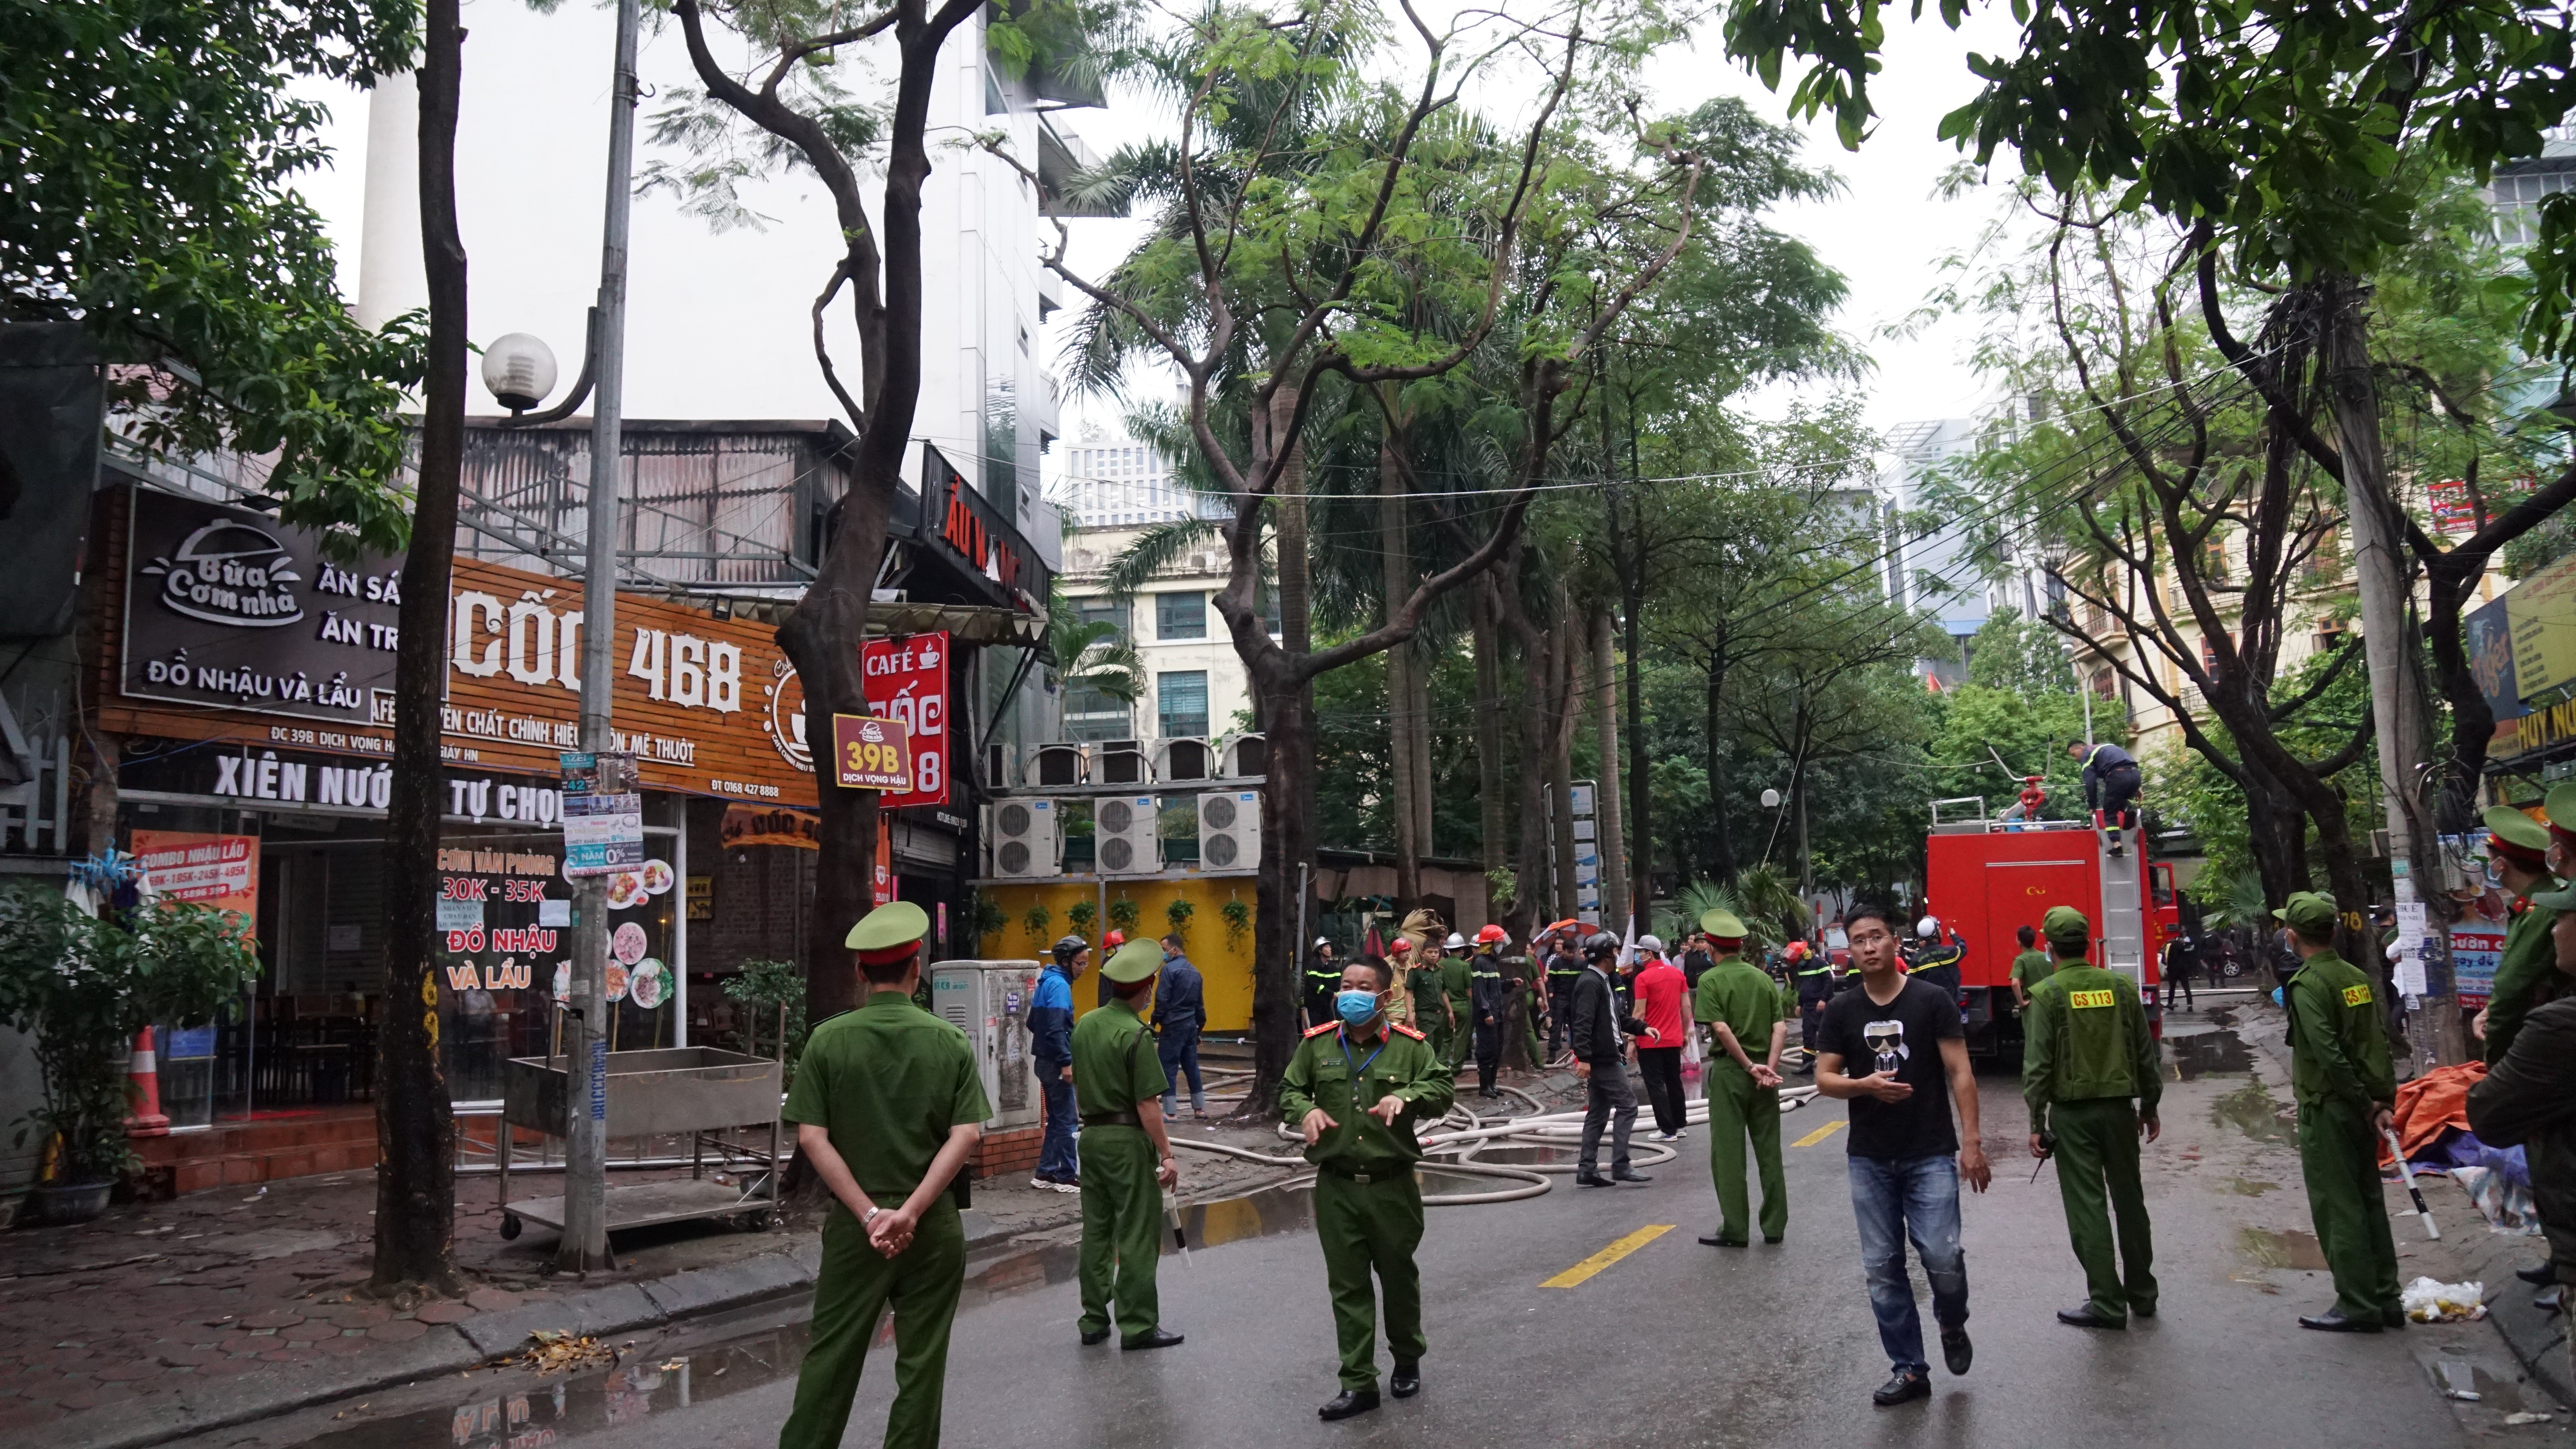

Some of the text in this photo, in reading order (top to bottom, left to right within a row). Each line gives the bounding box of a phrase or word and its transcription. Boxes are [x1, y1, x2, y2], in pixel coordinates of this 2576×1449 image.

[199, 557, 268, 587] Bữa
[319, 562, 358, 596] ĂN
[167, 569, 298, 615] Cơm nhà
[322, 610, 361, 645] ĂN
[627, 627, 742, 713] 468
[866, 646, 914, 676] CAFÉ
[148, 647, 361, 709] ĐỒ NHẬU VÀ LẨU
[271, 726, 287, 741] ĐC
[291, 729, 314, 744] 39B
[319, 732, 345, 749] DỊCH
[350, 735, 380, 754] VỌNG
[464, 749, 478, 761] HN
[466, 708, 504, 738] CHẤT
[509, 714, 549, 743] CHÍNH
[630, 732, 650, 757] MÊ
[655, 737, 694, 762] THUỘT
[847, 742, 899, 773] 39B
[215, 751, 307, 802] XIÊN
[449, 778, 491, 823] TỰ
[568, 780, 585, 790] 42
[711, 779, 780, 797] ĐT 0168 427 8888
[843, 773, 907, 785] DỊCH VỌNG HẬU
[437, 846, 555, 876] CƠM VĂN PHÒNG
[606, 848, 625, 864] 0%
[442, 877, 488, 901] 30K
[505, 879, 547, 902] 35K
[447, 921, 557, 960] ĐỒ NHẬU
[447, 957, 532, 990] VÀ LẨU
[2073, 991, 2112, 1007] CS 113
[2345, 989, 2359, 1004] CS
